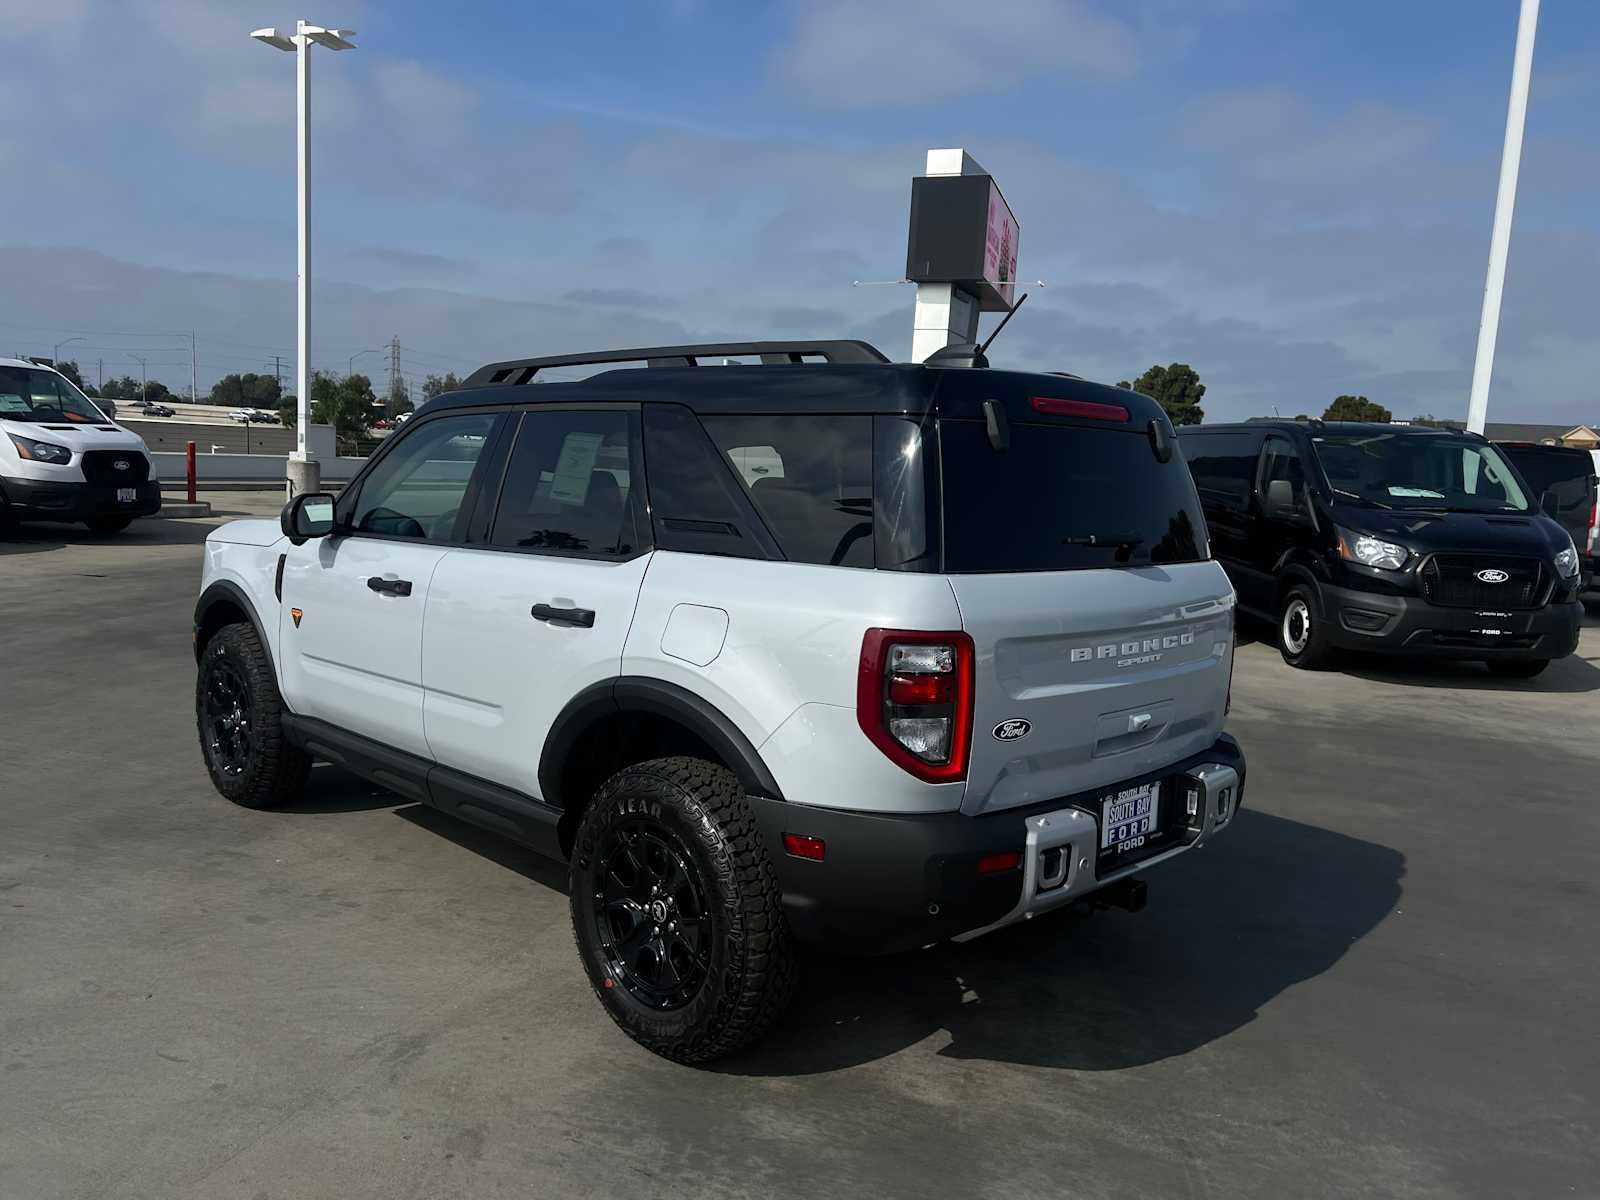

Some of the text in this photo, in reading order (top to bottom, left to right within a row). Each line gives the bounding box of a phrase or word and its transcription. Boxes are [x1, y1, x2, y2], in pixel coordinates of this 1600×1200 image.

[1071, 632, 1194, 662] BRONCO
[1117, 653, 1163, 667] SPORT
[1000, 722, 1026, 738] Ford
[1118, 787, 1138, 799] SOUTH
[1109, 796, 1151, 823] SOUTH BAY
[1109, 818, 1149, 843] FORD
[1117, 836, 1145, 853] FORD
